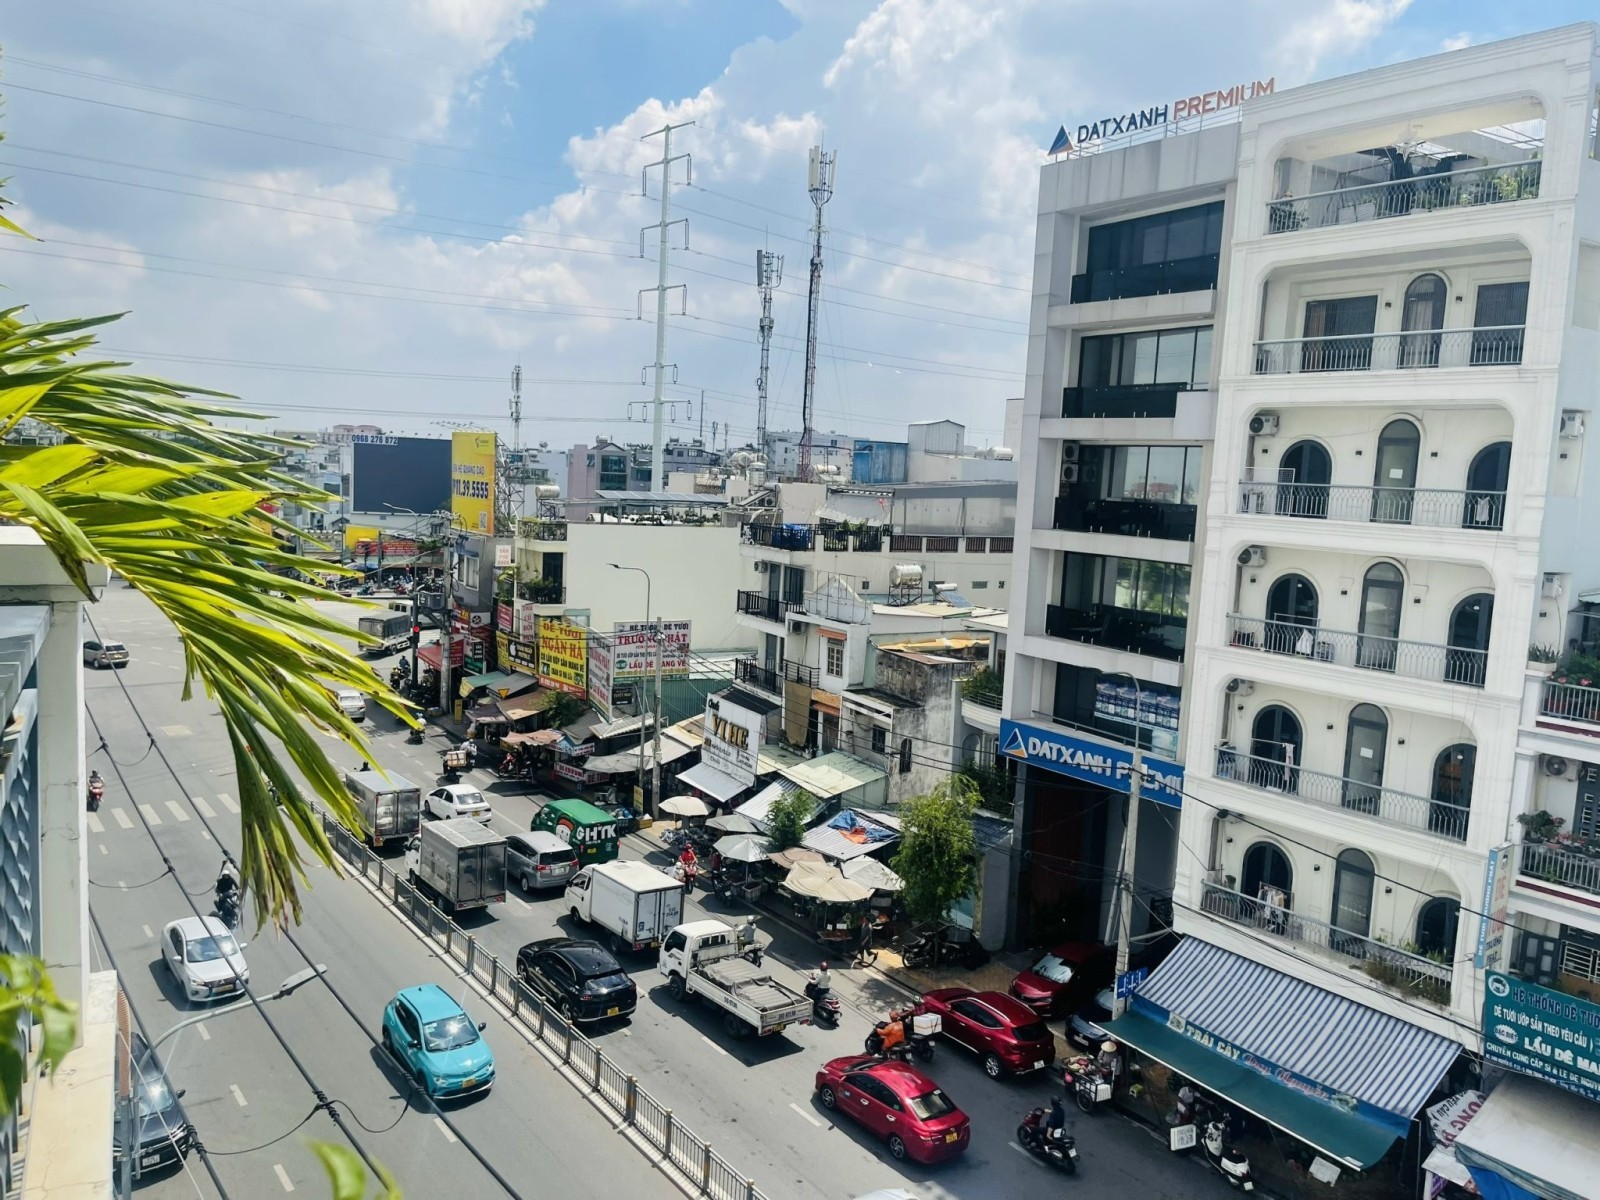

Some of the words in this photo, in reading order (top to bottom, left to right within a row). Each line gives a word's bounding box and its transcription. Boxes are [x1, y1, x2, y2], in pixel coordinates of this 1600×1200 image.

[1076, 104, 1169, 144] DATXANH
[1173, 77, 1275, 122] PREMIUM
[385, 435, 398, 445] 872
[541, 634, 567, 656] NGÂN
[569, 641, 584, 660] HÀ
[1028, 736, 1113, 777] DATXANH
[576, 824, 617, 841] GHTK
[1528, 991, 1561, 1016] THỐNG
[1564, 1002, 1578, 1021] DÊ
[1186, 1025, 1215, 1048] TRÁI
[1216, 1041, 1241, 1060] CÂY
[1543, 1022, 1560, 1038] THEO
[1560, 1027, 1574, 1043] YÊU
[1486, 1042, 1511, 1058] CHUYÊN
[1512, 1051, 1529, 1065] CUNG
[1554, 1047, 1574, 1066] DÊ
